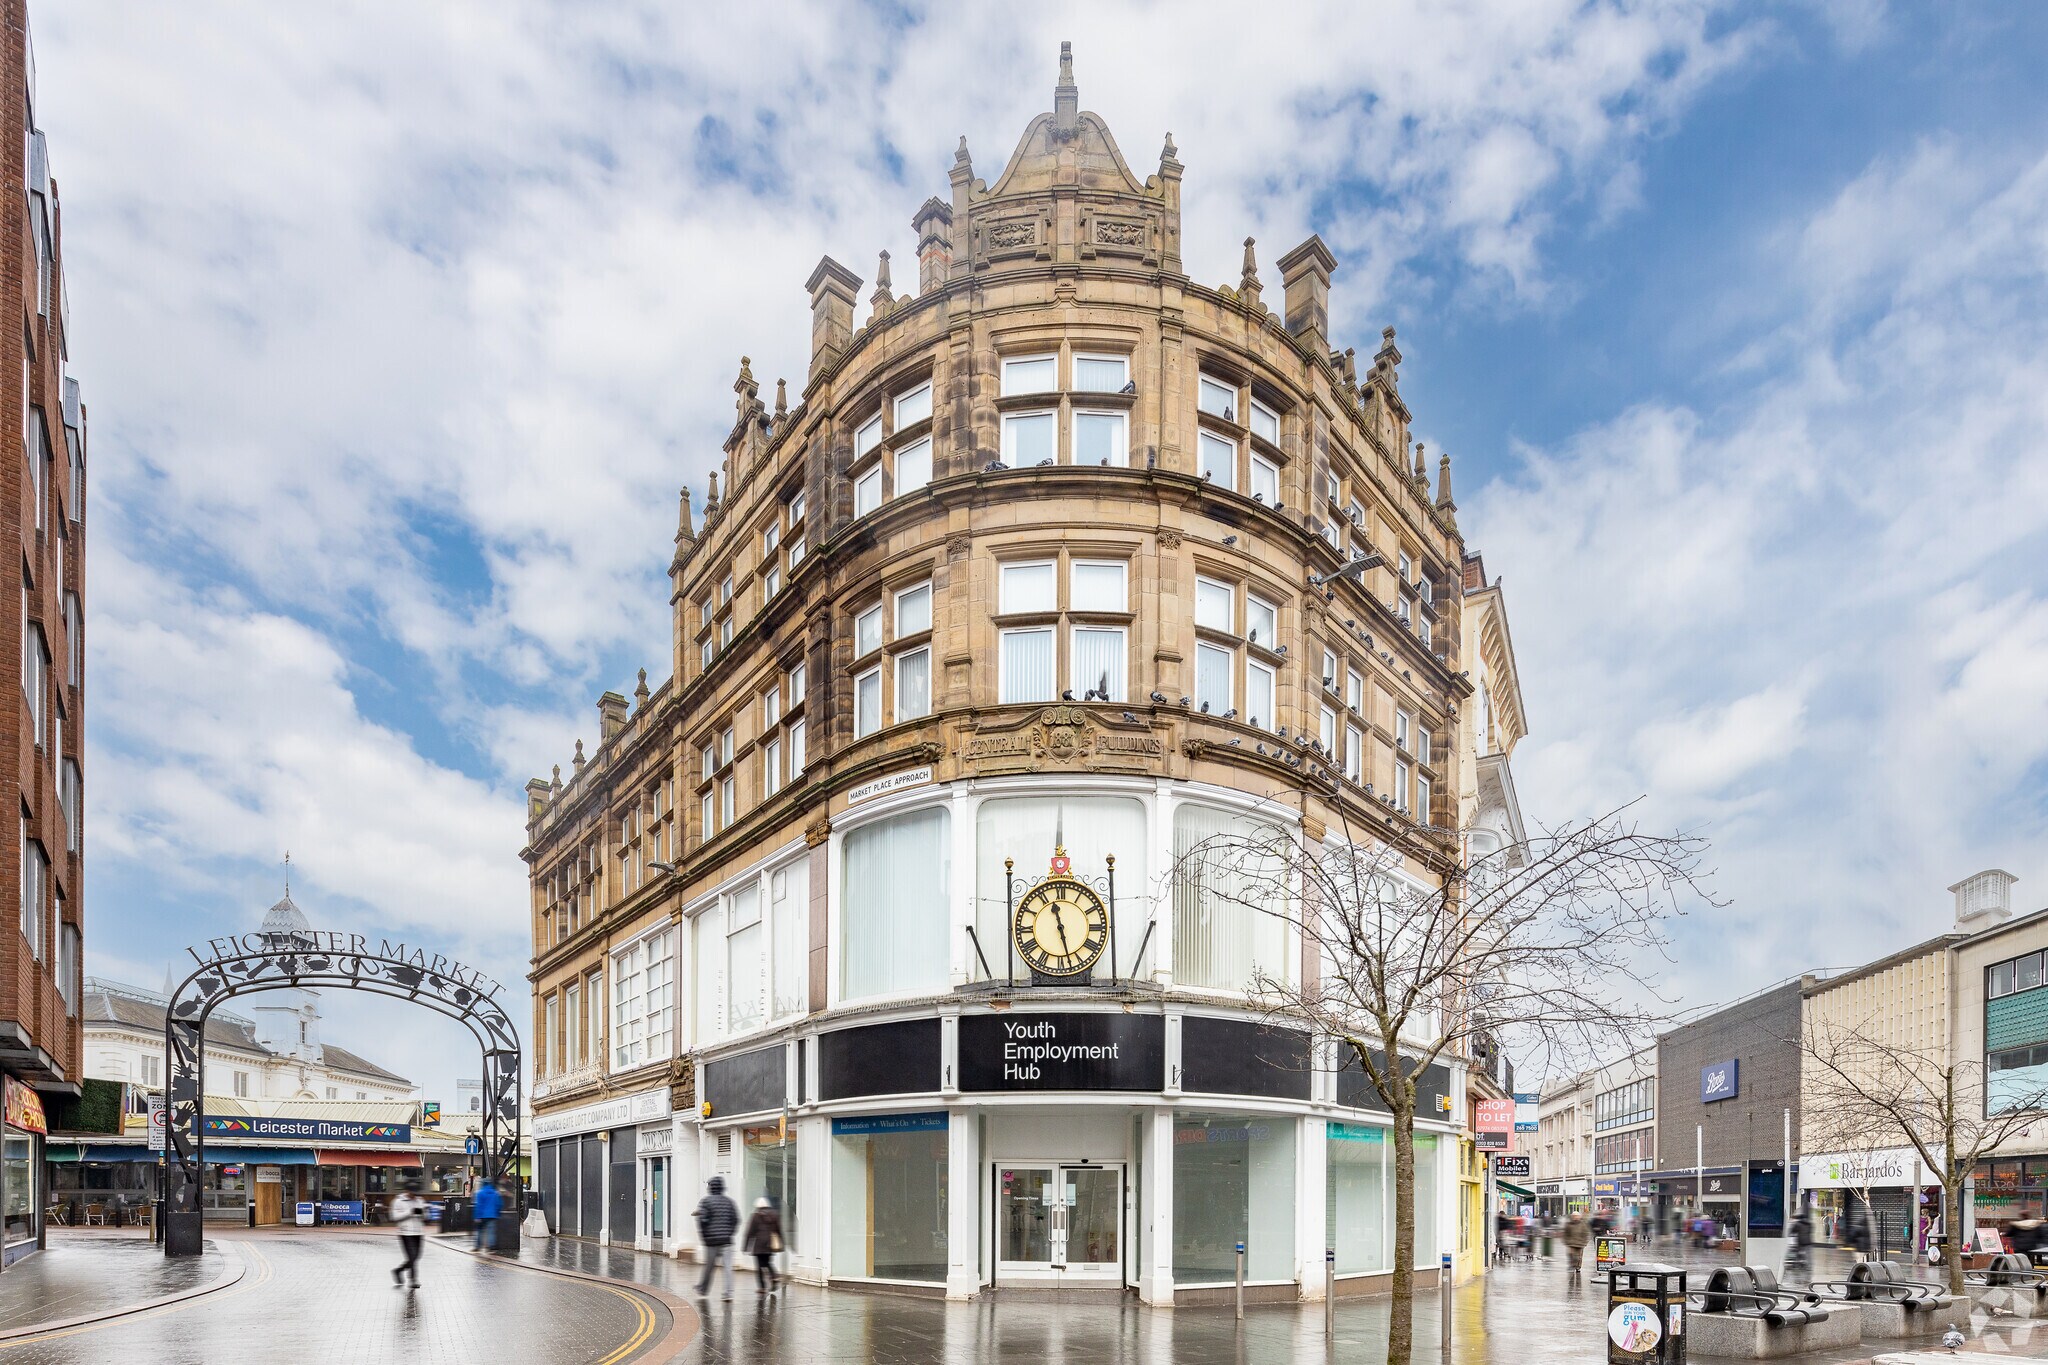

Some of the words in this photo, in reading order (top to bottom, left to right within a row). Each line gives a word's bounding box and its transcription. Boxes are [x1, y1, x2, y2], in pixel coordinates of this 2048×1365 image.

[1099, 735, 1161, 753] BUILDINGS
[850, 786, 872, 800] MARKET
[874, 780, 892, 792] PLACE
[894, 771, 928, 786] APPROACH
[186, 930, 368, 967] LEICESTER
[380, 938, 507, 999] MARKET
[1004, 1022, 1056, 1038] Youth
[1004, 1042, 1119, 1063] Employment
[1004, 1063, 1041, 1080] Hub
[1478, 1102, 1506, 1110] SHOP
[536, 1121, 544, 1134] THE
[588, 1106, 616, 1124] COMPANY
[617, 1104, 628, 1118] LTD
[840, 1122, 869, 1130] Information
[880, 1120, 899, 1128] What's
[920, 1118, 940, 1126] Tickets
[1477, 1112, 1492, 1122] TO
[1495, 1113, 1512, 1122] LET
[253, 1120, 315, 1135] Leicester
[318, 1122, 364, 1136] Market
[1842, 1160, 1902, 1179] Barnardo's
[1623, 1315, 1646, 1326] gum
